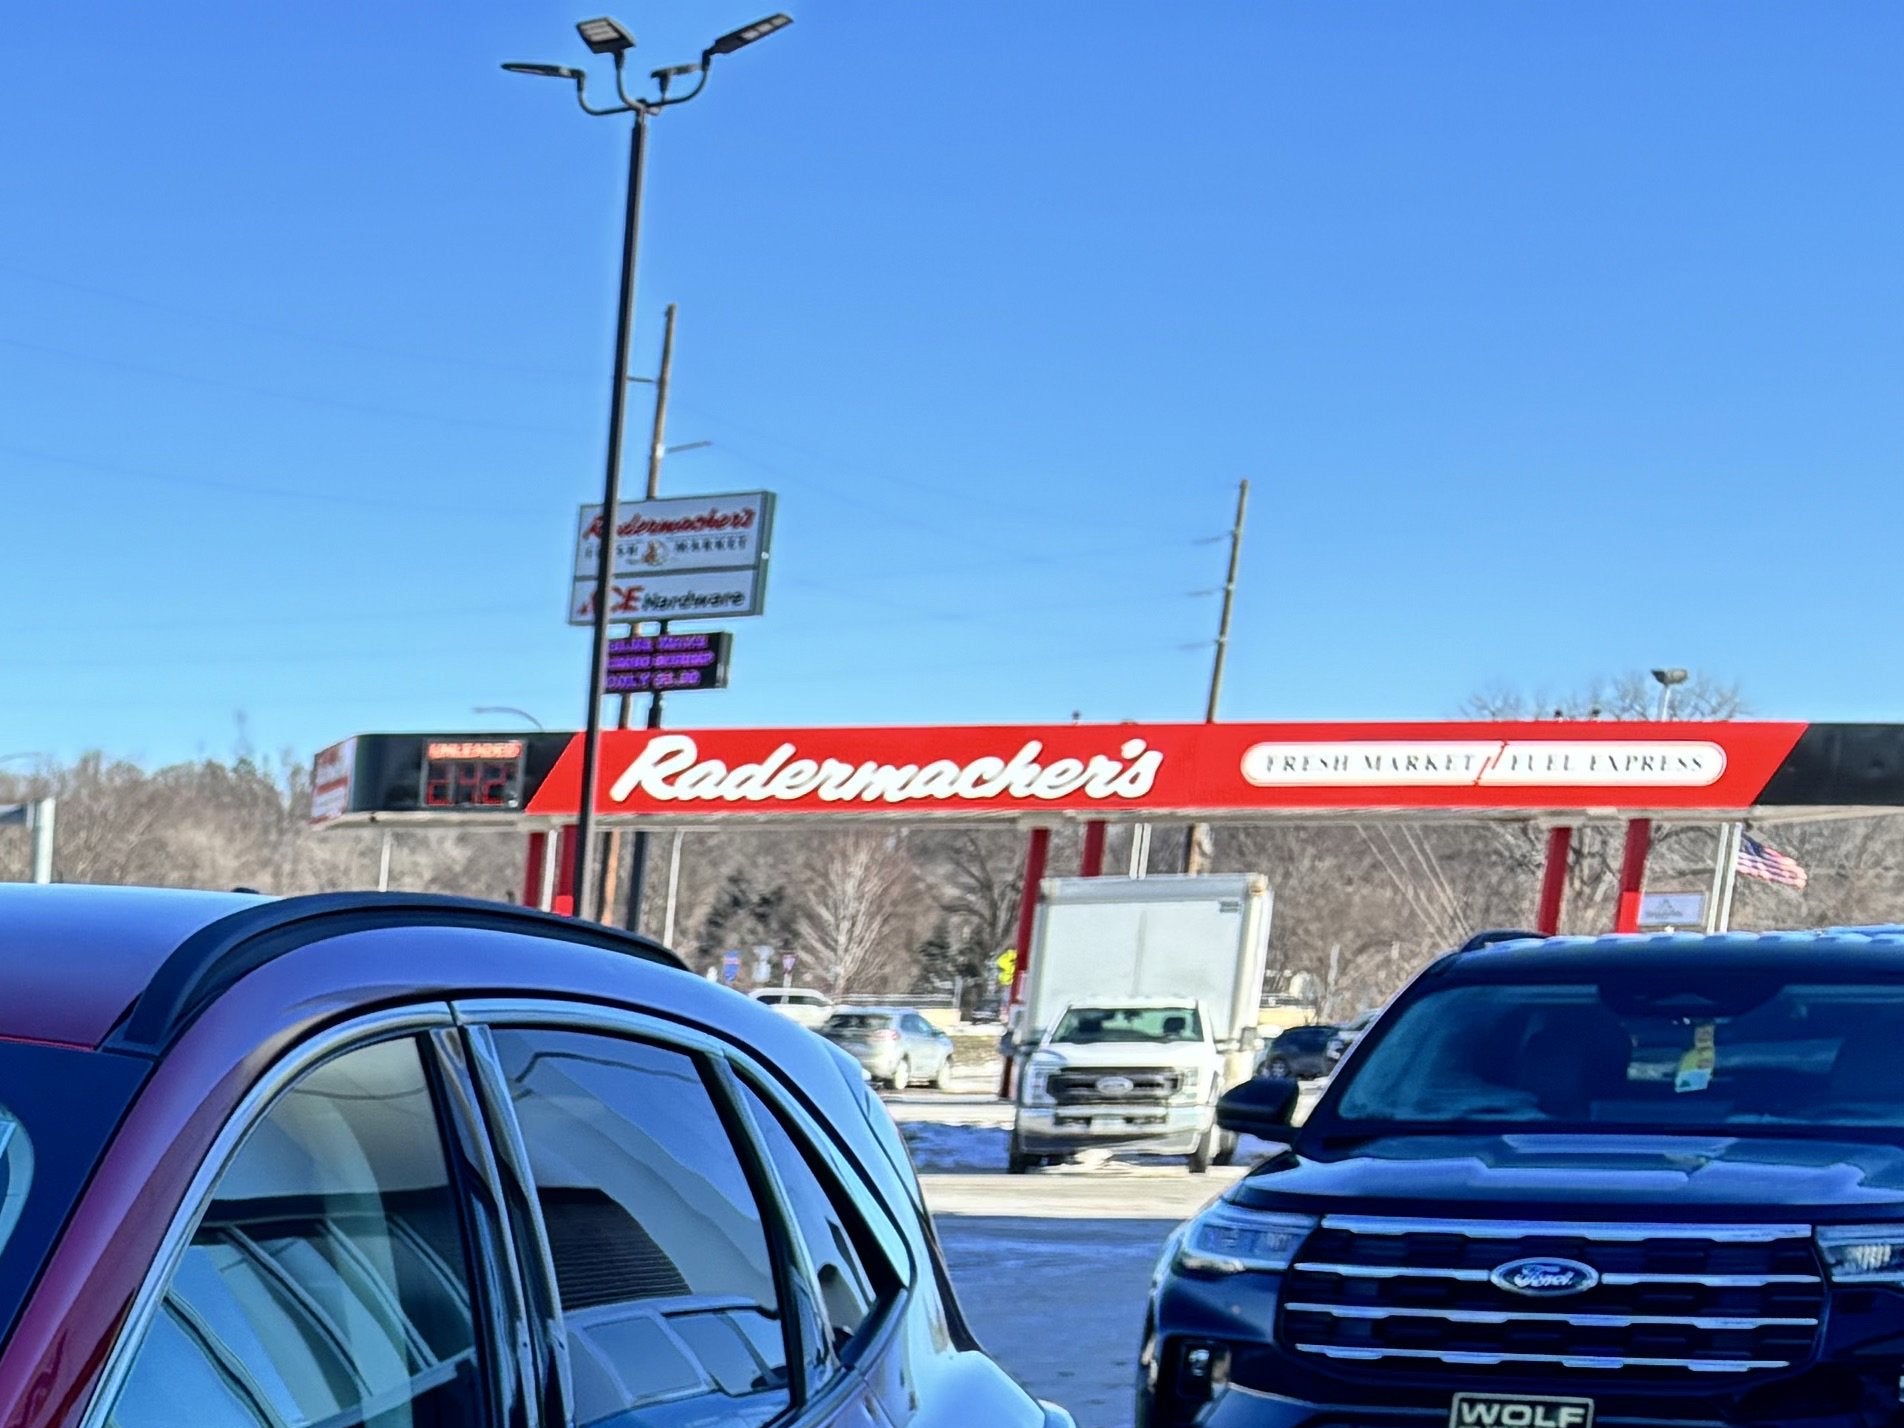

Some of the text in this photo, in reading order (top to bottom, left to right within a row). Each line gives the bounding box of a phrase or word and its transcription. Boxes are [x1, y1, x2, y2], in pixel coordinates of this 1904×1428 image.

[610, 734, 1165, 802] Radermacher's
[1265, 754, 1704, 773] FRESH MARKET FUEL EXPRESS
[1513, 1264, 1576, 1288] Ford
[1461, 1402, 1586, 1428] WOLF
